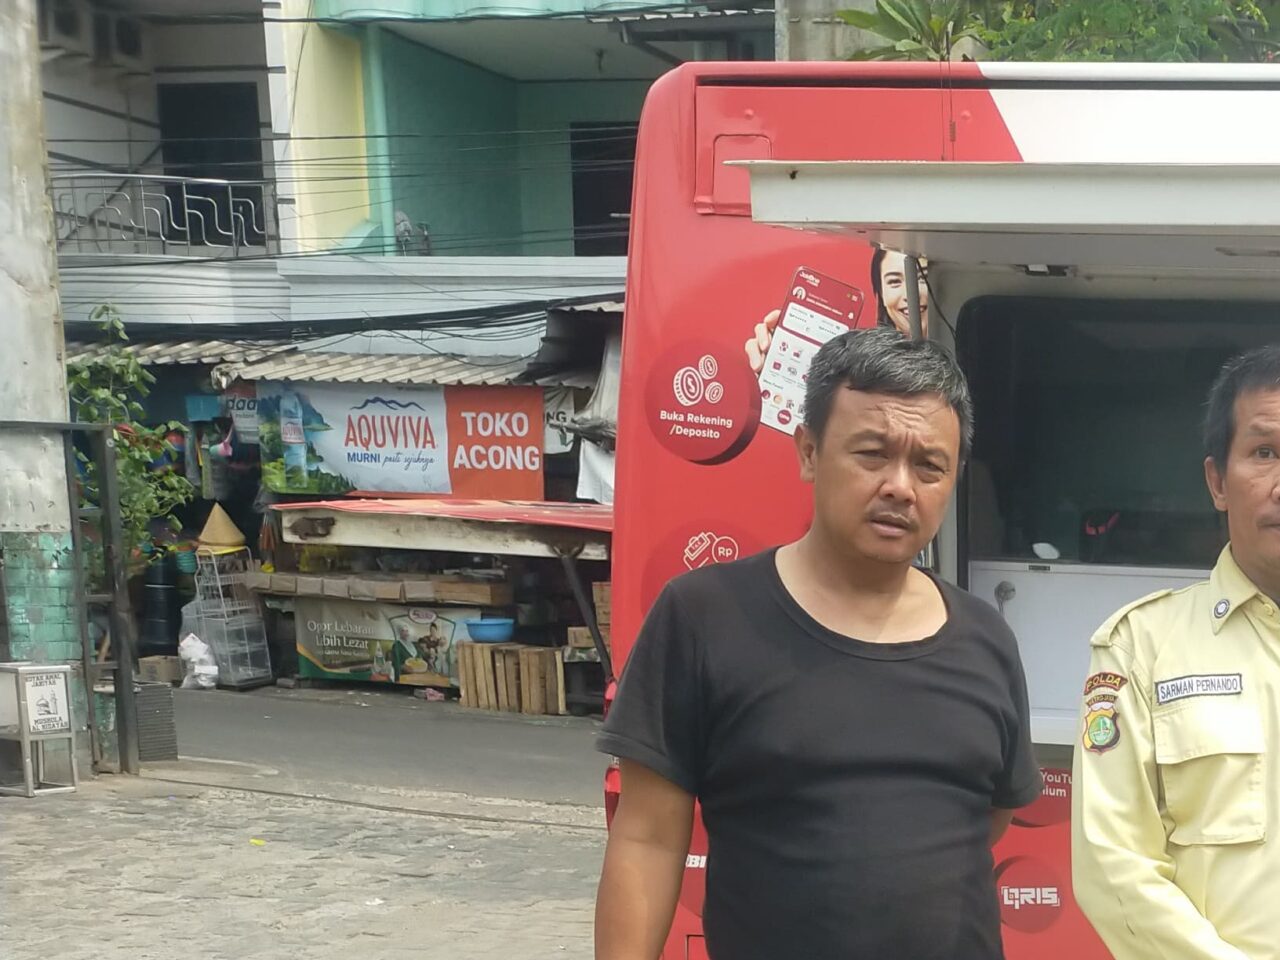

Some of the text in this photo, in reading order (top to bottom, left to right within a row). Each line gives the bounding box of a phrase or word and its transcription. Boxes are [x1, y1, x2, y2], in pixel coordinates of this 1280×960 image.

[461, 411, 529, 437] TOKO
[660, 410, 733, 428] Buka Rekening
[344, 414, 436, 450] AQUVIVA
[669, 424, 720, 439] /Deposito
[347, 452, 380, 463] MURNI
[453, 444, 540, 471] ACONG
[717, 546, 733, 558] Rp
[1086, 674, 1122, 690] POLDA
[1160, 678, 1238, 700] SARMAN PERNANDO
[1042, 785, 1066, 797] ium
